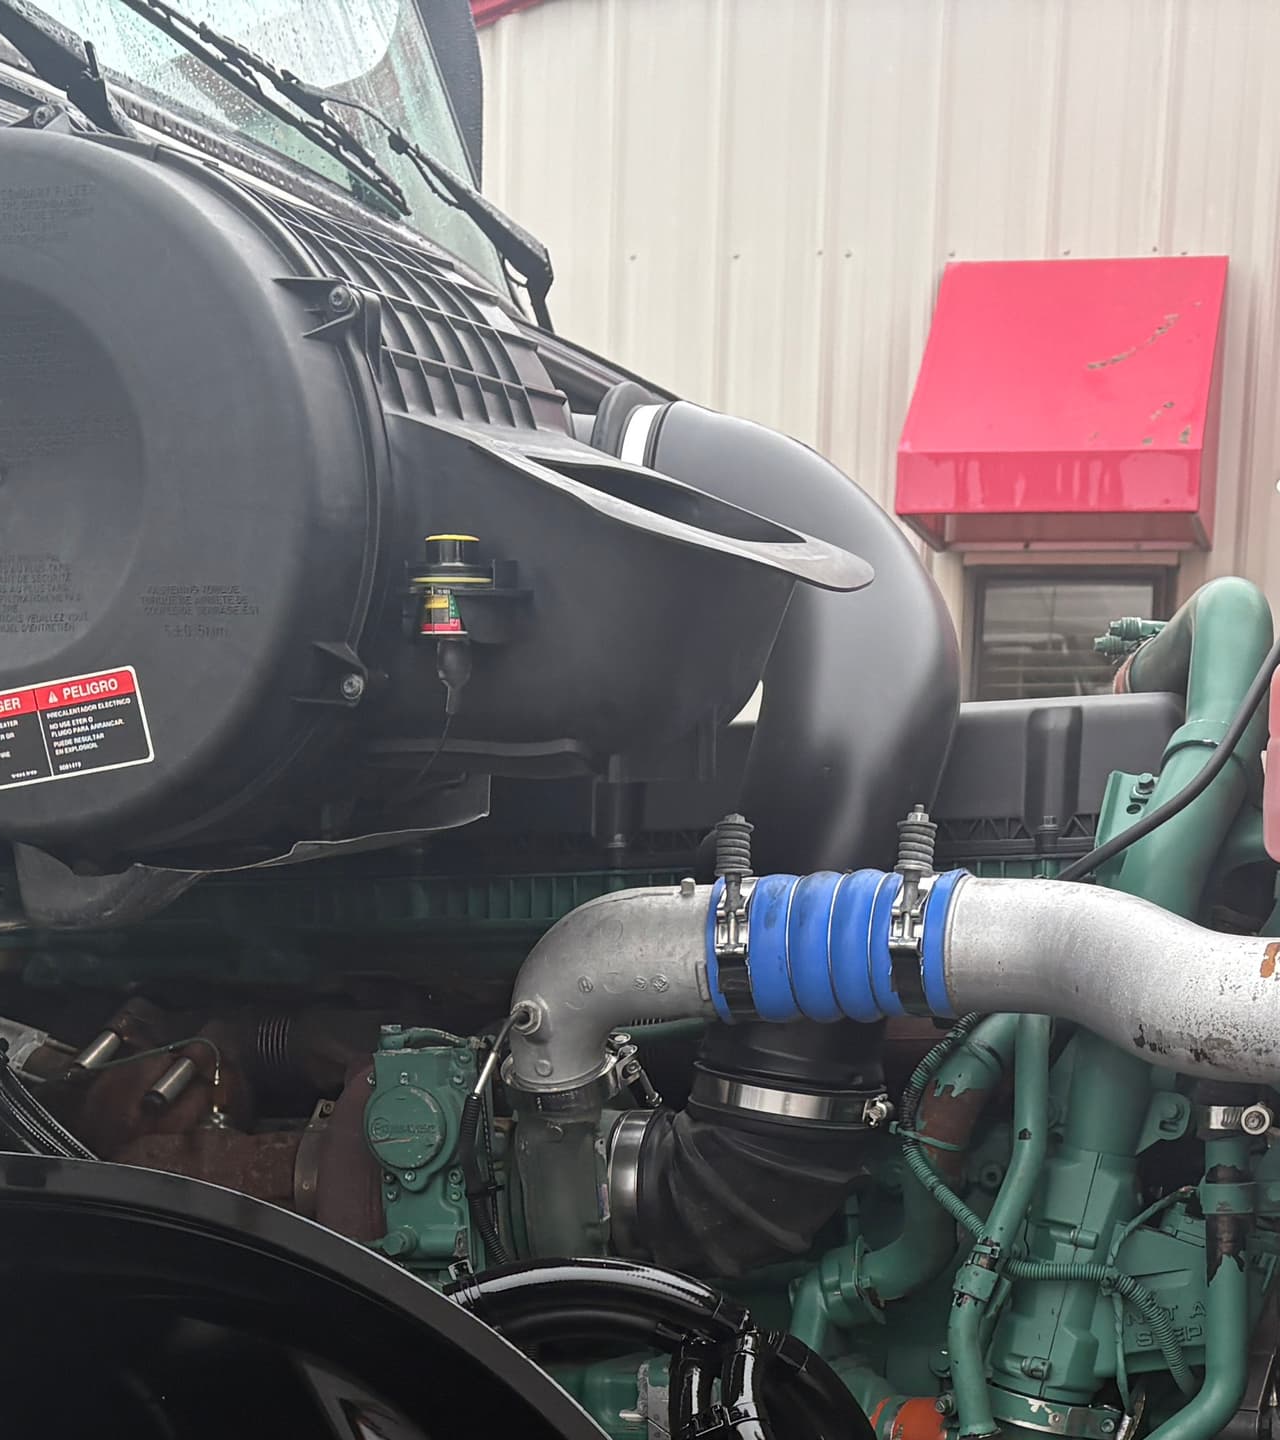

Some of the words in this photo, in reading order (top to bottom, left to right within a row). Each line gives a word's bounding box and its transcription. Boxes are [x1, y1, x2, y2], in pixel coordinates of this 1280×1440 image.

[62, 678, 118, 700] PELIGRO
[46, 704, 97, 720] PRECALENTADOR
[97, 697, 131, 709] ELECTRICO
[49, 722, 59, 730] NO
[59, 720, 72, 730] USE
[72, 717, 88, 727] ETER
[87, 715, 94, 723] O
[5, 732, 15, 741] OR
[73, 726, 90, 736] PARA
[53, 738, 73, 748] PUEDE
[73, 732, 105, 744] RESULTAR
[55, 747, 64, 756] EN
